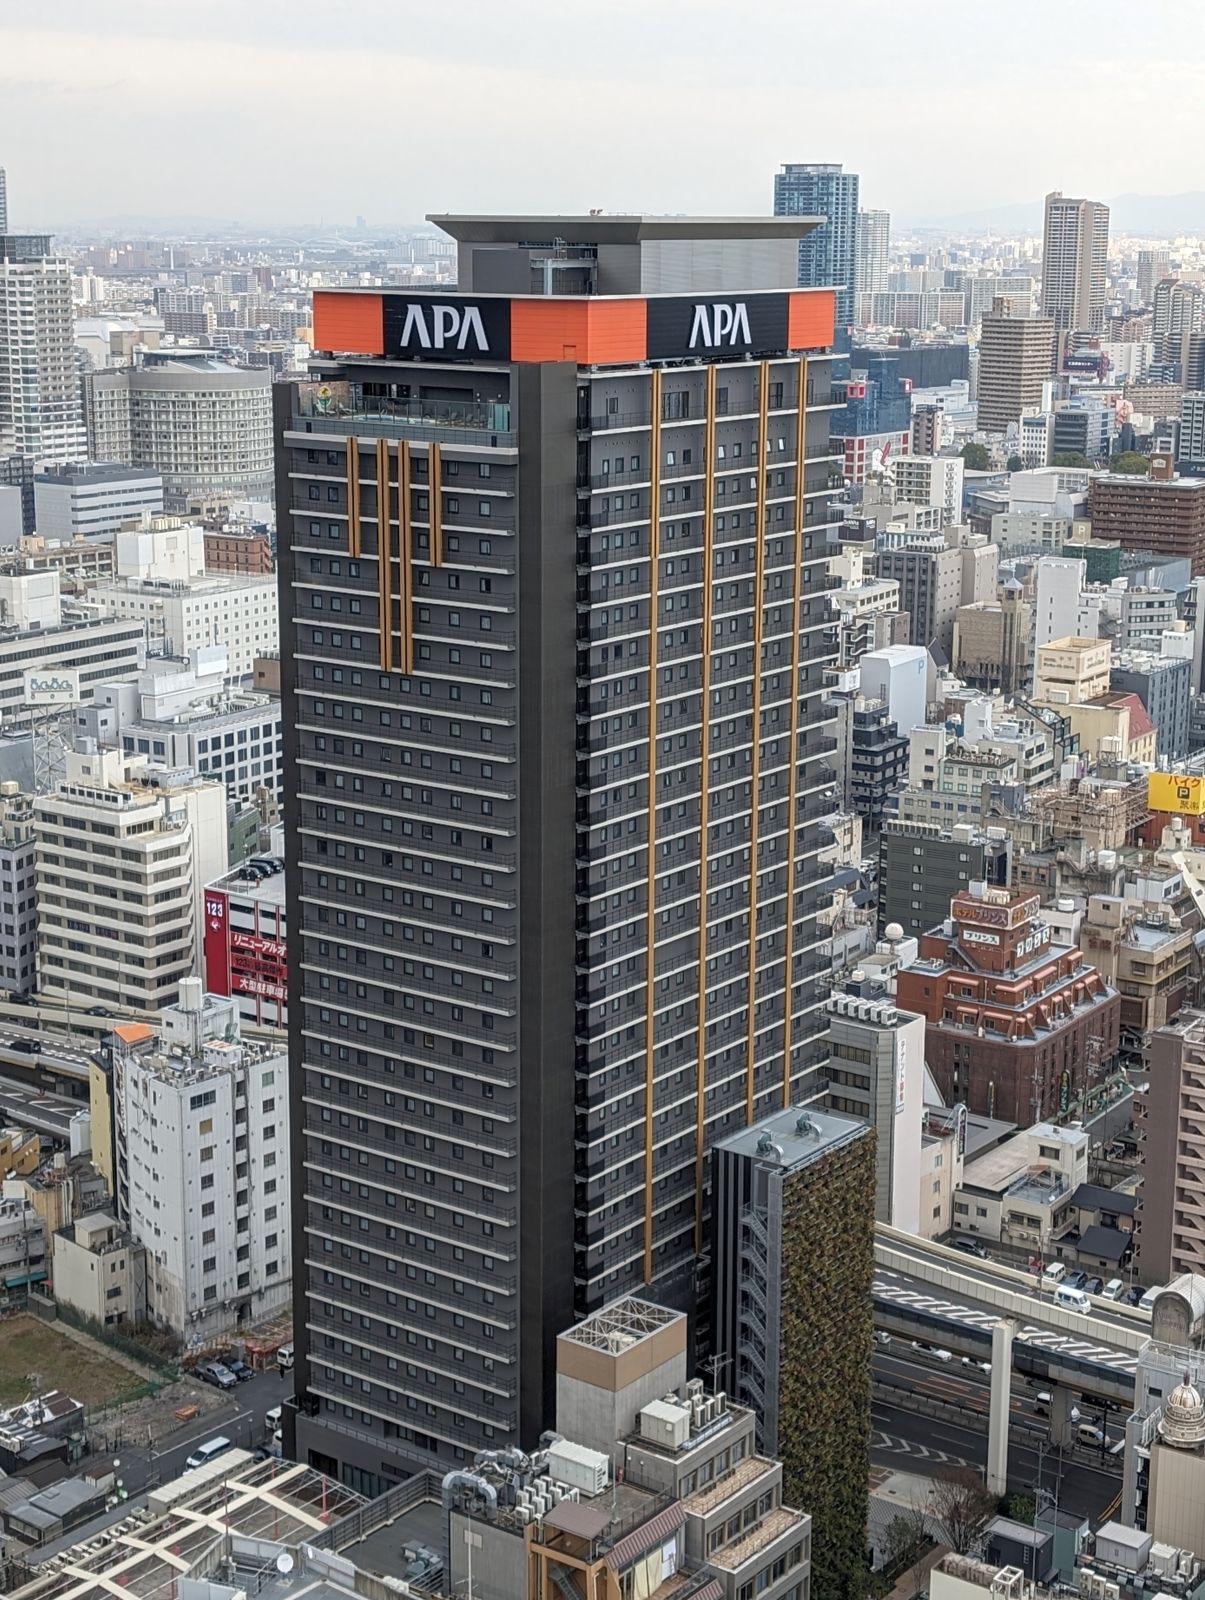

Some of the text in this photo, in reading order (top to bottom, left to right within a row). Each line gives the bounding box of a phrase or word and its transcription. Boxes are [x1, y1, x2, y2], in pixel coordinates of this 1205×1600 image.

[400, 303, 490, 351] APA
[688, 303, 752, 348] APA
[1079, 524, 1086, 534] P
[918, 659, 925, 674] P
[1168, 775, 1201, 788] バイク
[207, 902, 223, 917] 123
